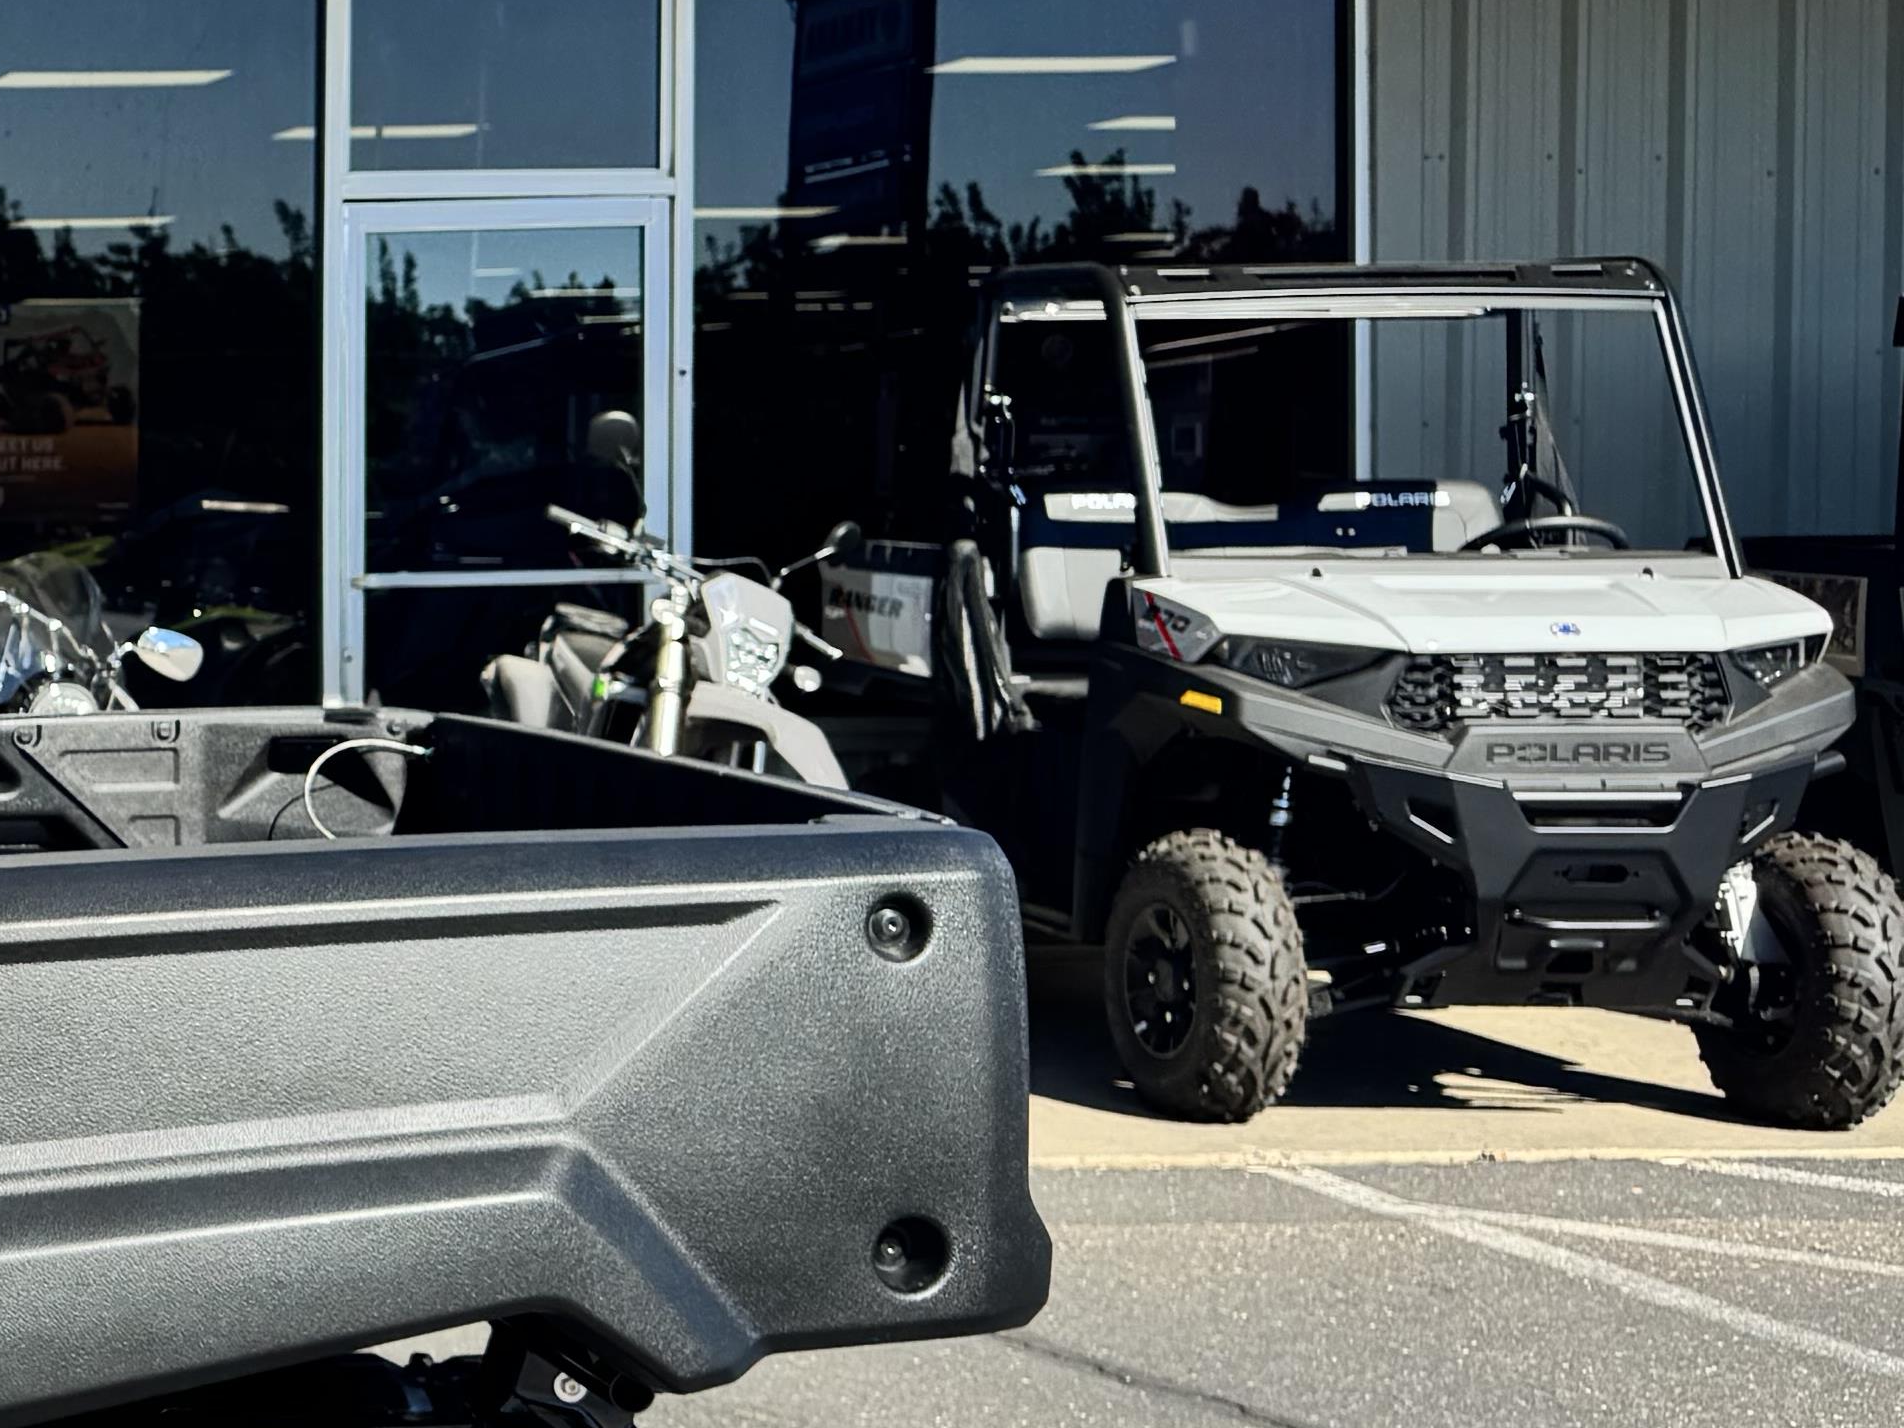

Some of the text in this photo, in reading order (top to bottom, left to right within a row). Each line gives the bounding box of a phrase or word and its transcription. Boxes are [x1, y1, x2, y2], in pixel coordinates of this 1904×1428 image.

[1071, 492, 1137, 510] POLA
[1354, 490, 1452, 508] POLARIS
[1485, 741, 1672, 764] POLARIS
